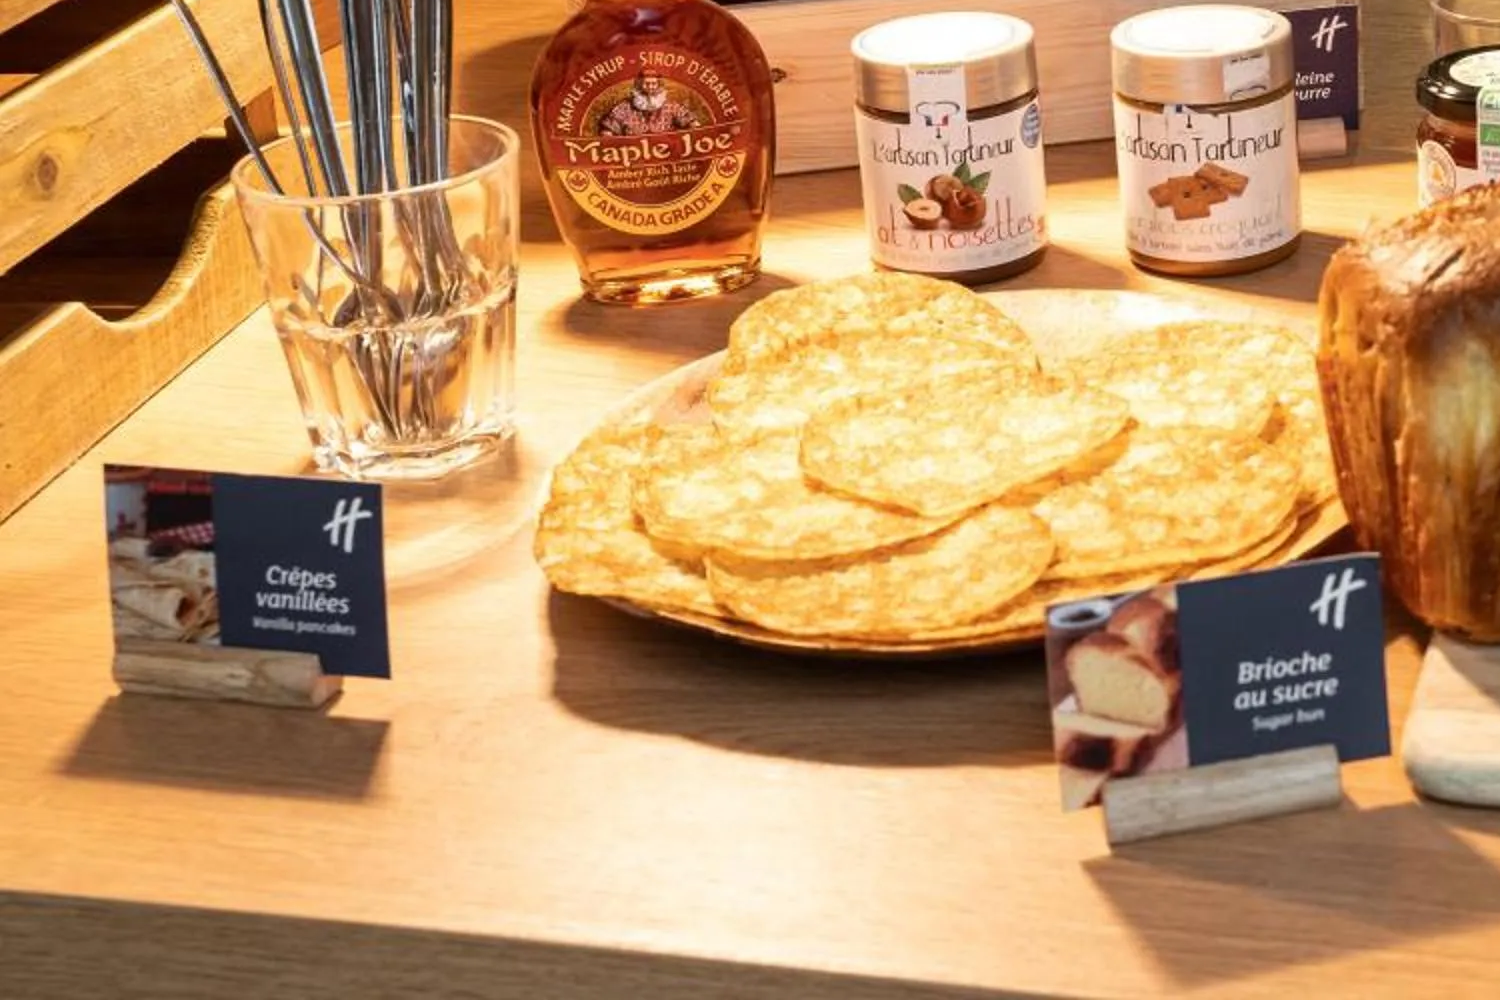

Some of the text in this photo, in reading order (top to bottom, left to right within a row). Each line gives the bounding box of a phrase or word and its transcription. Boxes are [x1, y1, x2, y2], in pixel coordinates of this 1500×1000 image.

[557, 81, 587, 132] MAPLE
[581, 55, 626, 89] SYRUP
[639, 51, 686, 68] SIROP
[687, 59, 739, 118] D'ÉRABLE
[1295, 71, 1335, 86] leine
[1295, 86, 1332, 101] urre
[564, 132, 733, 167] Maple Joe
[1193, 113, 1285, 164] Tartineur
[588, 181, 725, 227] CANADA GRADE A
[928, 197, 1034, 250] noisettes
[265, 565, 337, 590] Crêpes
[255, 590, 350, 614] vanillées
[253, 616, 357, 637] Vanilla pancakes
[1237, 651, 1332, 685] Brioche
[1234, 676, 1340, 711] au sucre
[1252, 707, 1325, 732] Sugar bun
